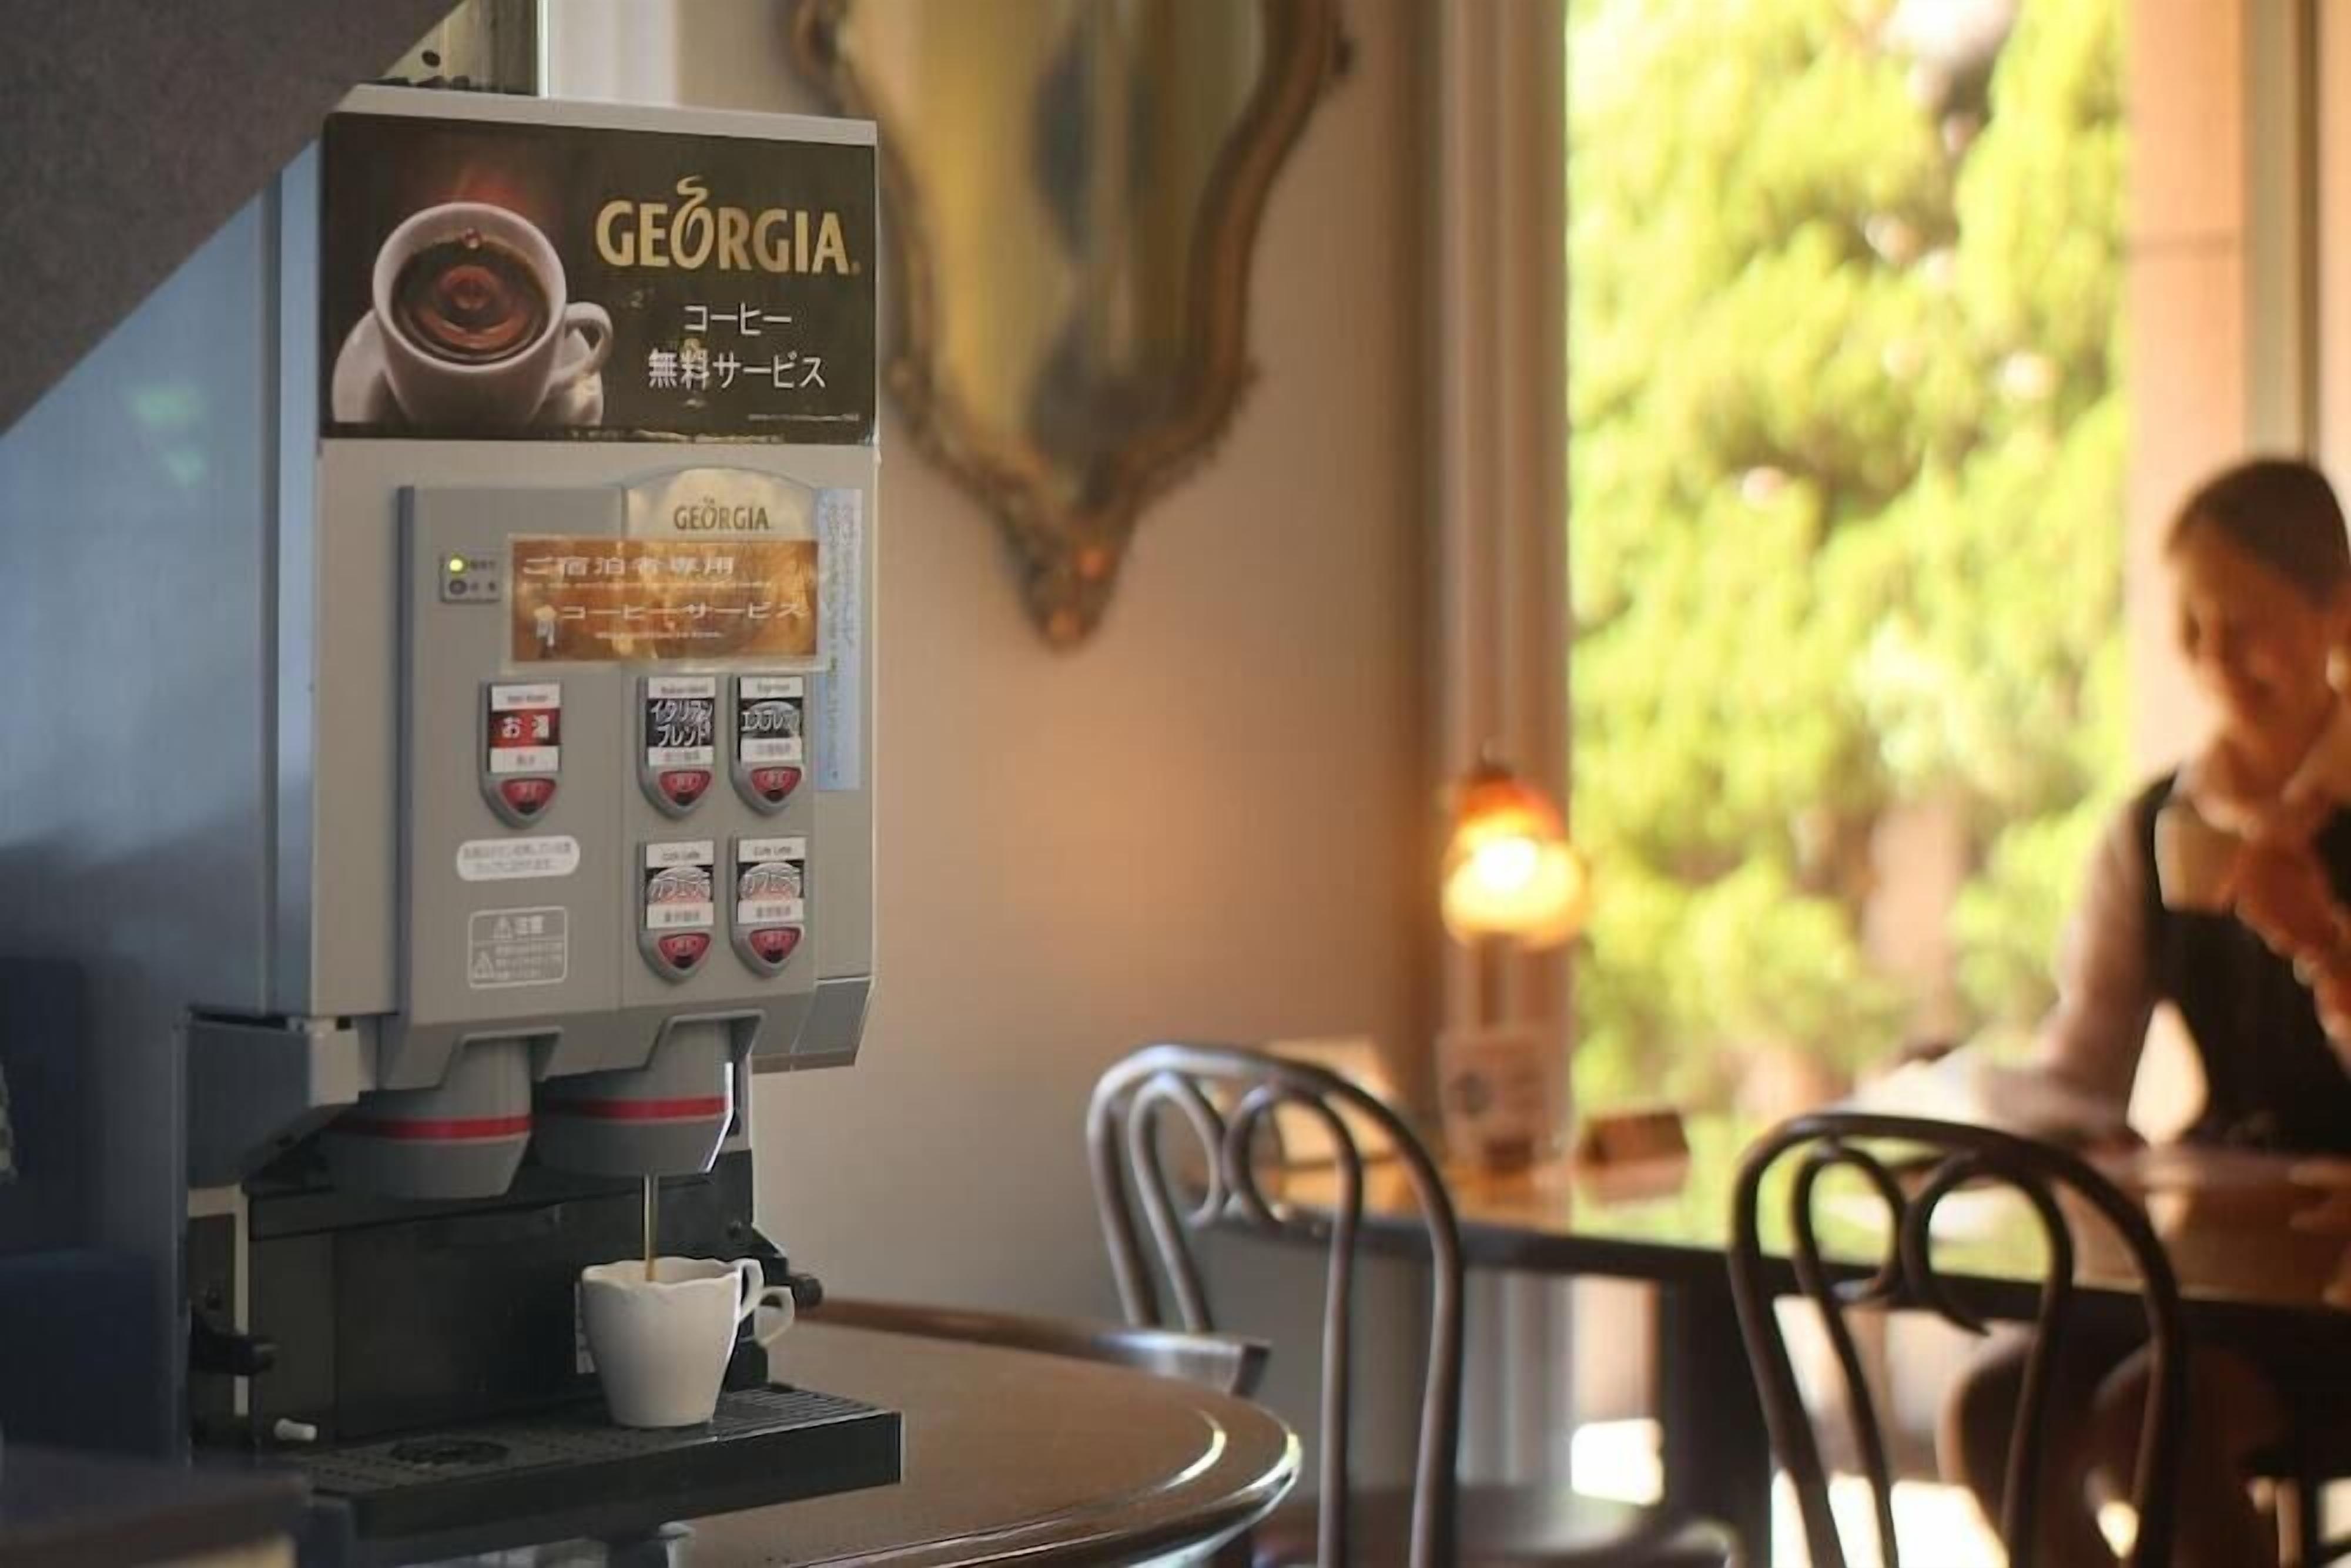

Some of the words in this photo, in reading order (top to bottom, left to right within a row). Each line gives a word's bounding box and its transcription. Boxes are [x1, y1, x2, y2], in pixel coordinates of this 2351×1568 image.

[595, 175, 852, 275] GEORGIA
[684, 301, 792, 336] コーヒー
[648, 348, 826, 389] 無料サービス
[674, 495, 771, 531] GEORGIA
